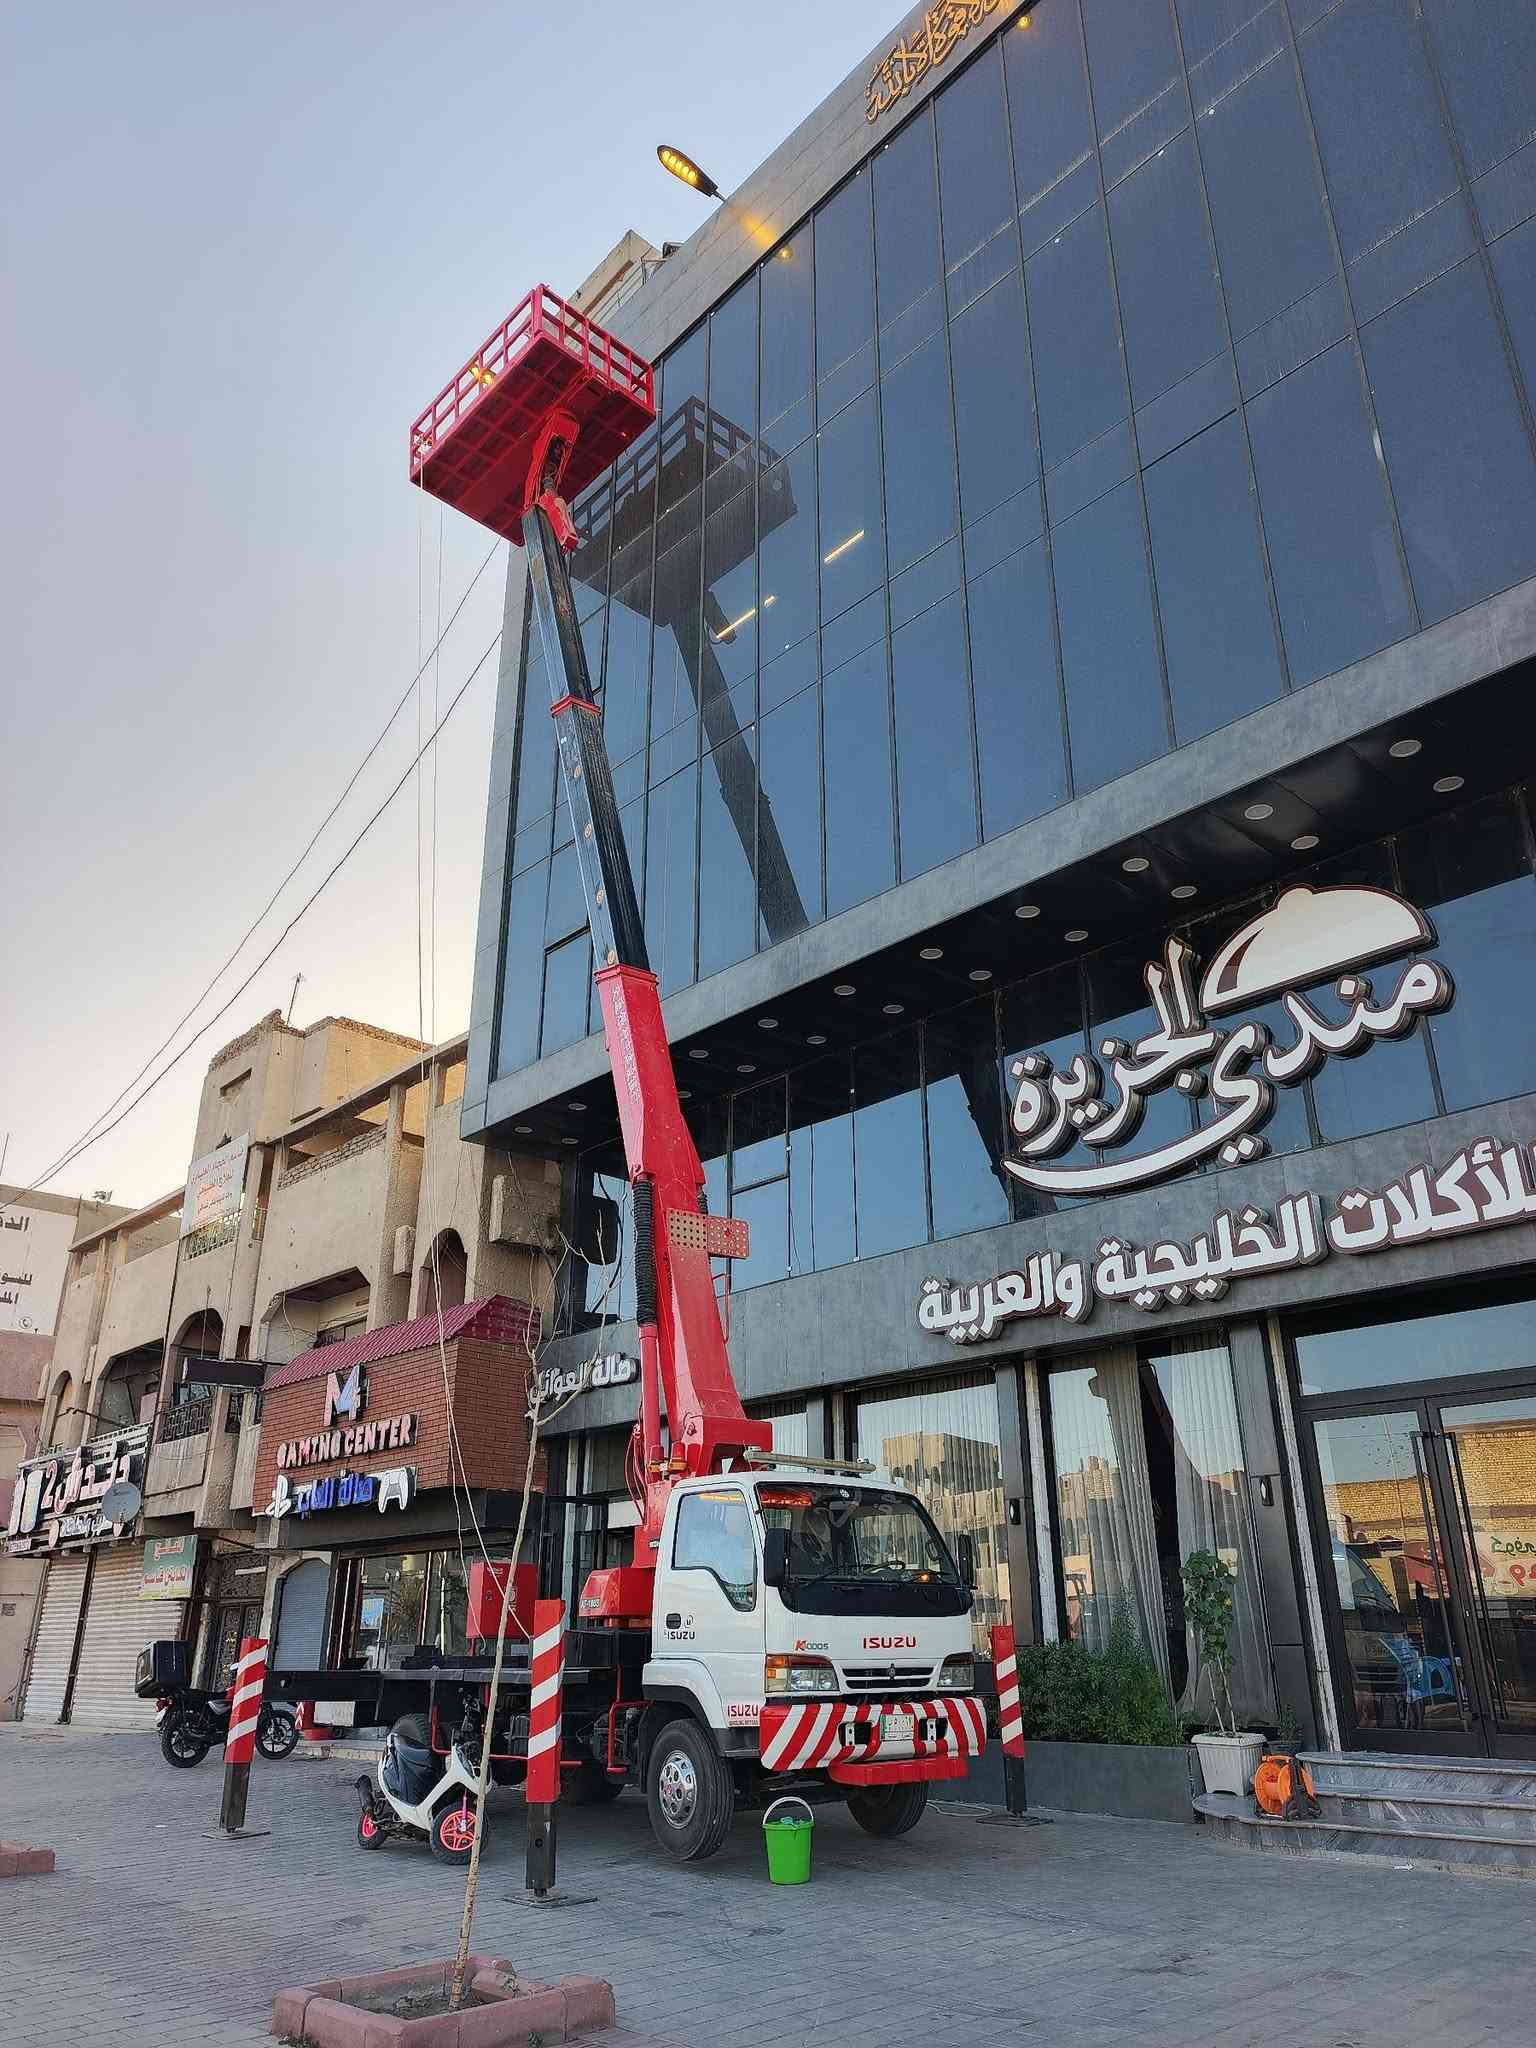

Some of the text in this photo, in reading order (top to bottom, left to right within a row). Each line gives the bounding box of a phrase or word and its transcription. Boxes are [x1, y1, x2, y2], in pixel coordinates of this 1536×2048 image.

[1003, 936, 1441, 1190] مندي الجزيرة
[1095, 1193, 1322, 1307] الخليجية
[917, 1250, 1086, 1341] والعربية
[277, 1413, 414, 1469] GAMING CENTER
[667, 1631, 696, 1640] ISUZU
[863, 1635, 917, 1649] ISUZU
[727, 1704, 759, 1718] ISUZU
